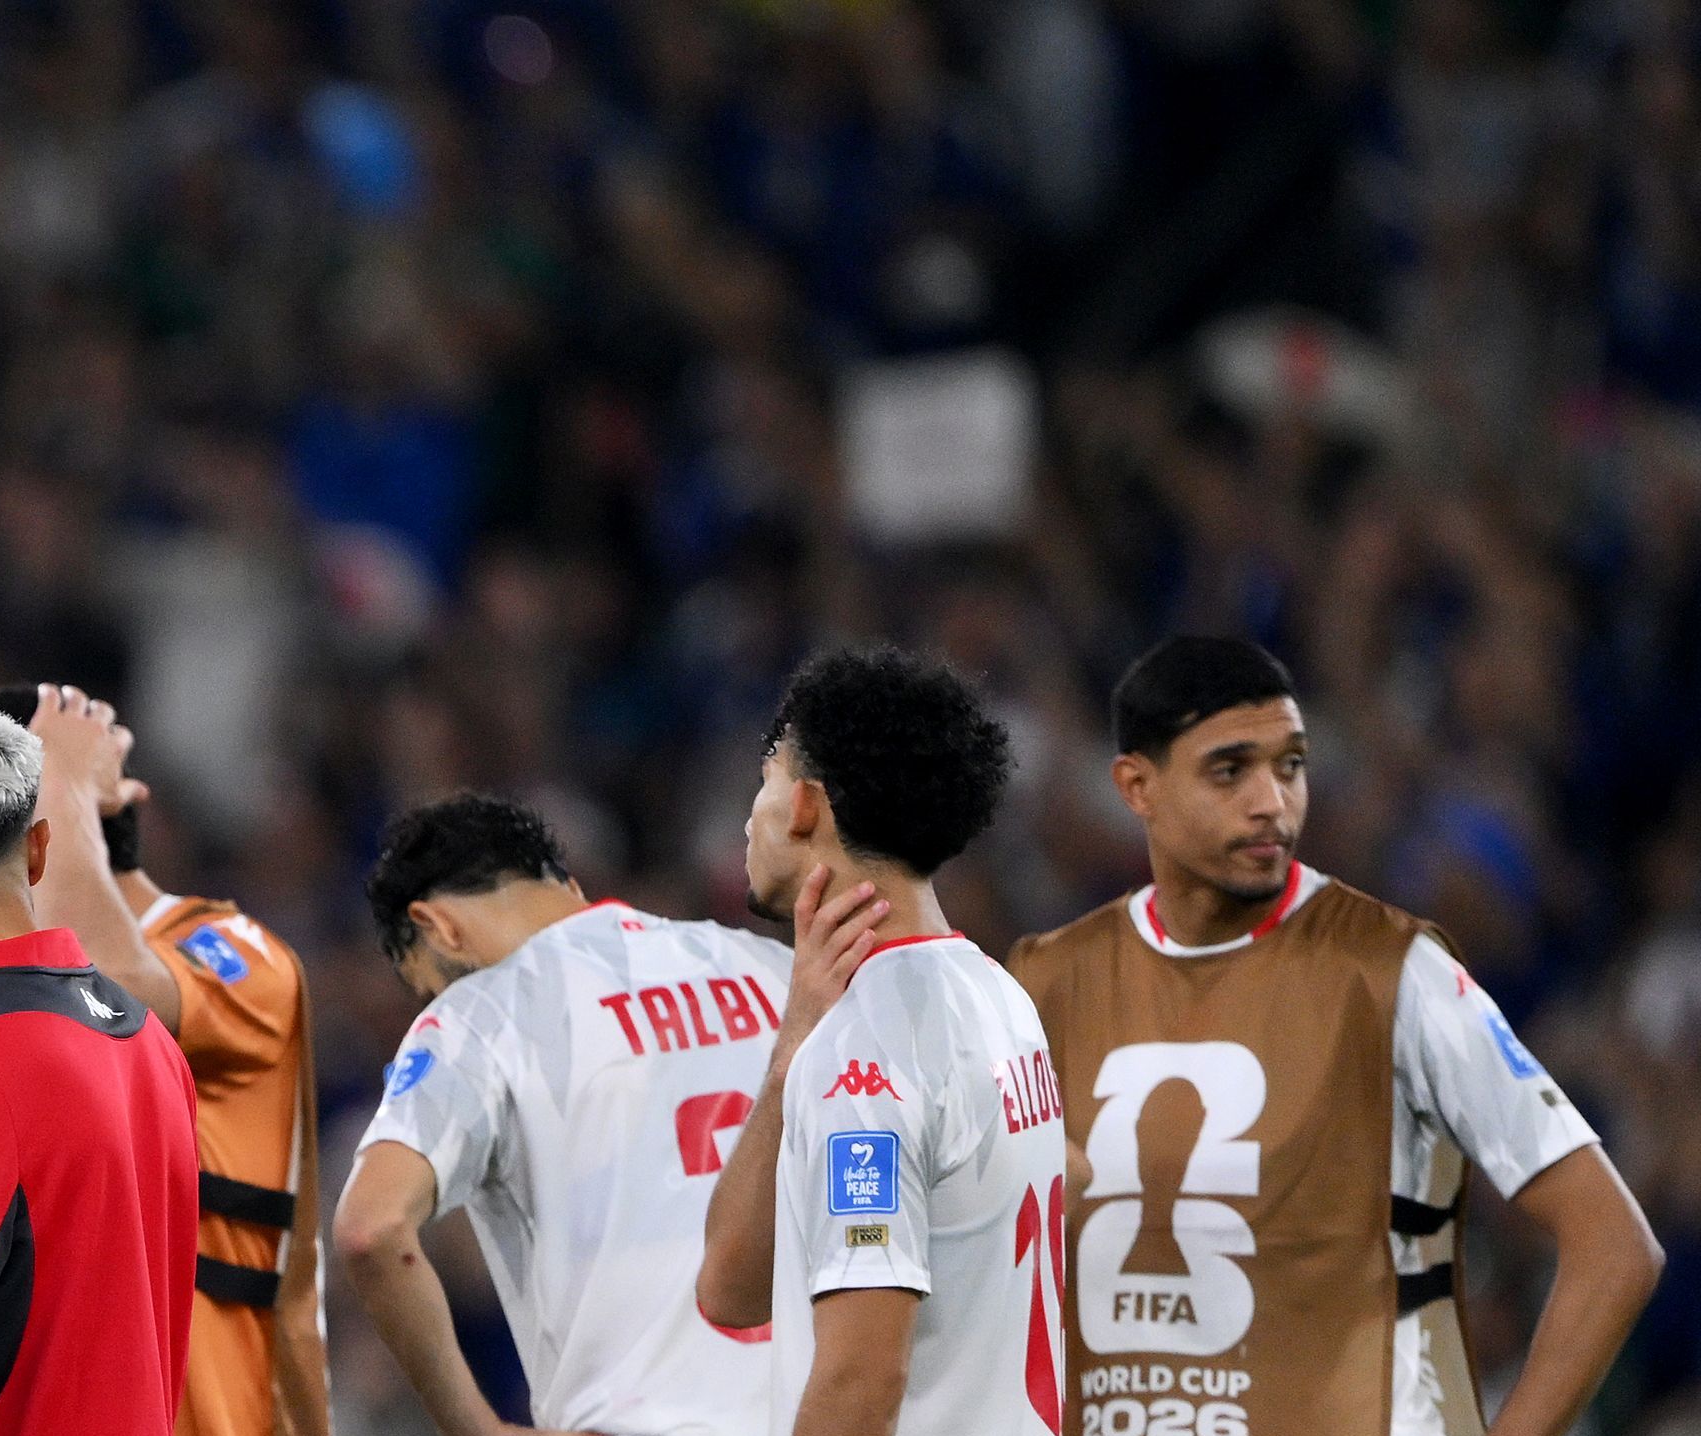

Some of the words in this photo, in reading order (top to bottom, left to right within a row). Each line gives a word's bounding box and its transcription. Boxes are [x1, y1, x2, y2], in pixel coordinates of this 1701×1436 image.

[600, 975, 781, 1055] TALBI
[846, 1180, 880, 1197] PEACE
[852, 1196, 873, 1205] FIFA
[1113, 1291, 1197, 1324] FIFA
[1180, 1366, 1252, 1398] CUP
